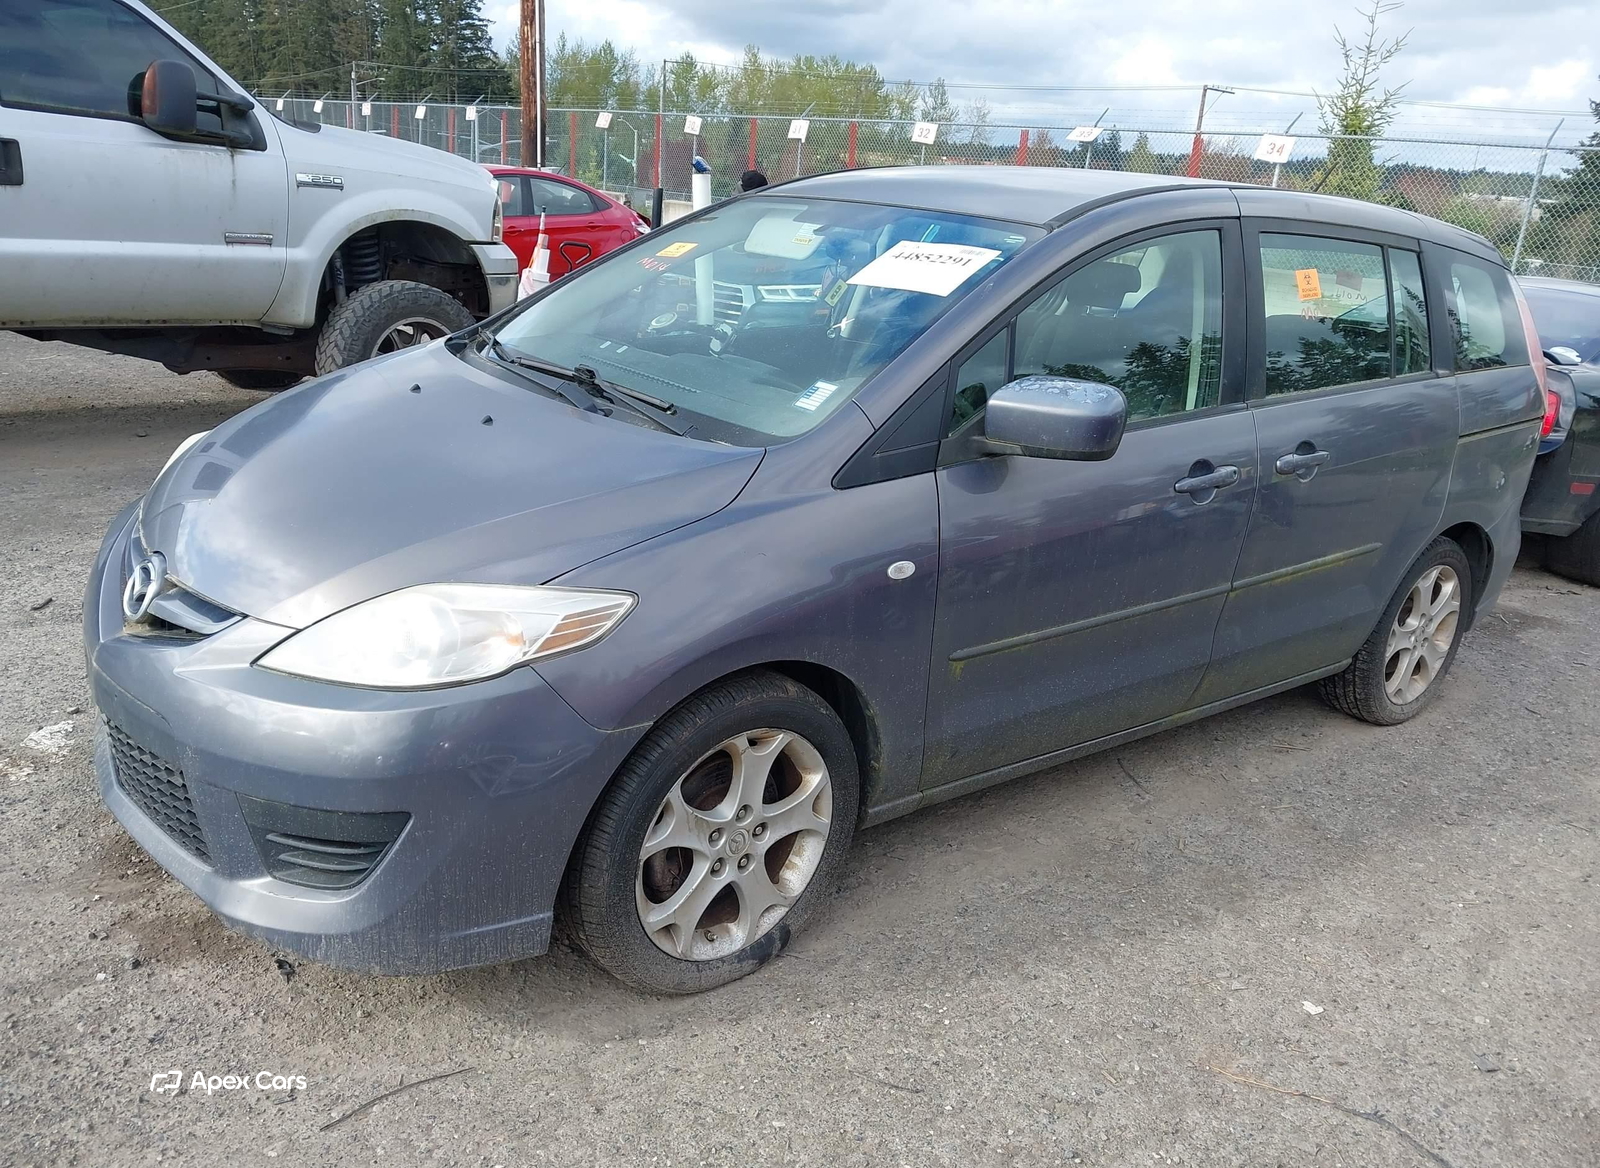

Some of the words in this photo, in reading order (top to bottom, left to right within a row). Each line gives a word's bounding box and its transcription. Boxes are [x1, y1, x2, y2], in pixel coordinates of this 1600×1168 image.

[917, 127, 931, 139] 32
[1076, 129, 1094, 138] 33
[1266, 142, 1286, 156] 34
[891, 251, 973, 267] 44852291
